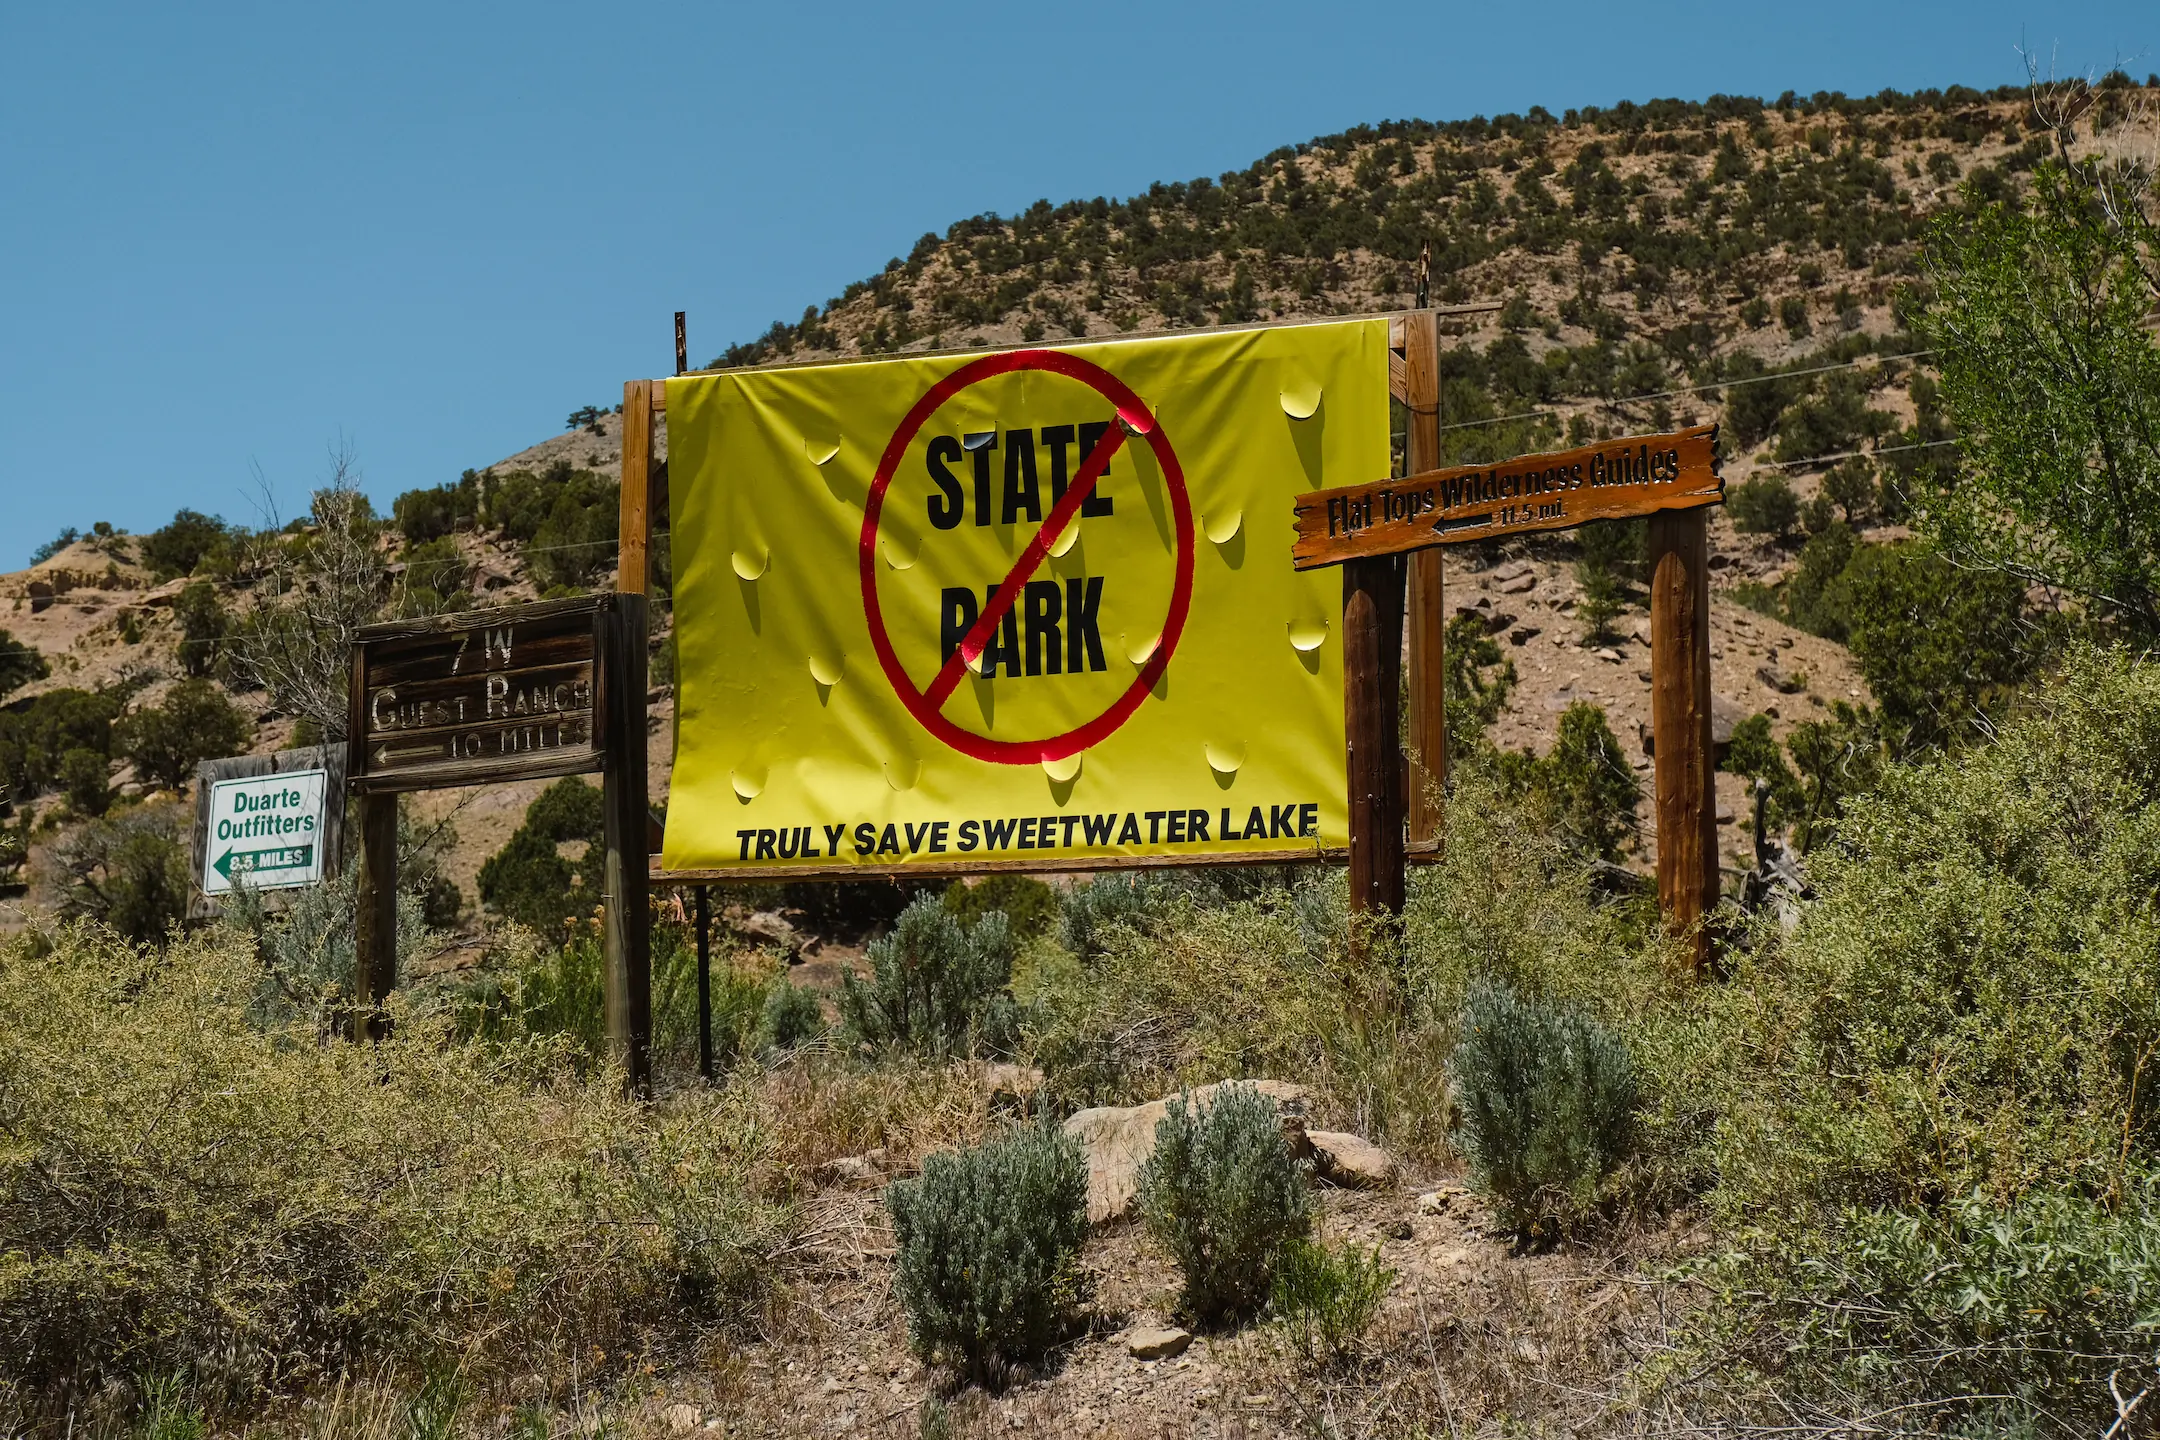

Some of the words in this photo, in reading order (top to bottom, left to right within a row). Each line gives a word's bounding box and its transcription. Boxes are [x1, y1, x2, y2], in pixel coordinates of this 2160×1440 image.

[926, 420, 1114, 530] STATE
[1327, 493, 1374, 539] Flat
[1379, 488, 1435, 525] Tops
[1440, 463, 1584, 511] Wilderness
[1589, 444, 1680, 488] Guides
[1500, 503, 1533, 527] 11.5
[451, 632, 470, 675] 7
[484, 627, 514, 671] W
[941, 576, 1108, 679] PARK
[371, 687, 468, 732] GUEST
[485, 674, 590, 719] RANCH
[449, 733, 482, 759] 10
[500, 718, 589, 753] MILES
[234, 788, 301, 813] Duarte
[217, 814, 315, 841] Outfitters
[736, 823, 846, 861] TRULY
[854, 820, 950, 855] SAVE
[957, 809, 1211, 852] SWEETWATER
[1220, 803, 1318, 841] LAKE
[259, 849, 304, 868] MILES
